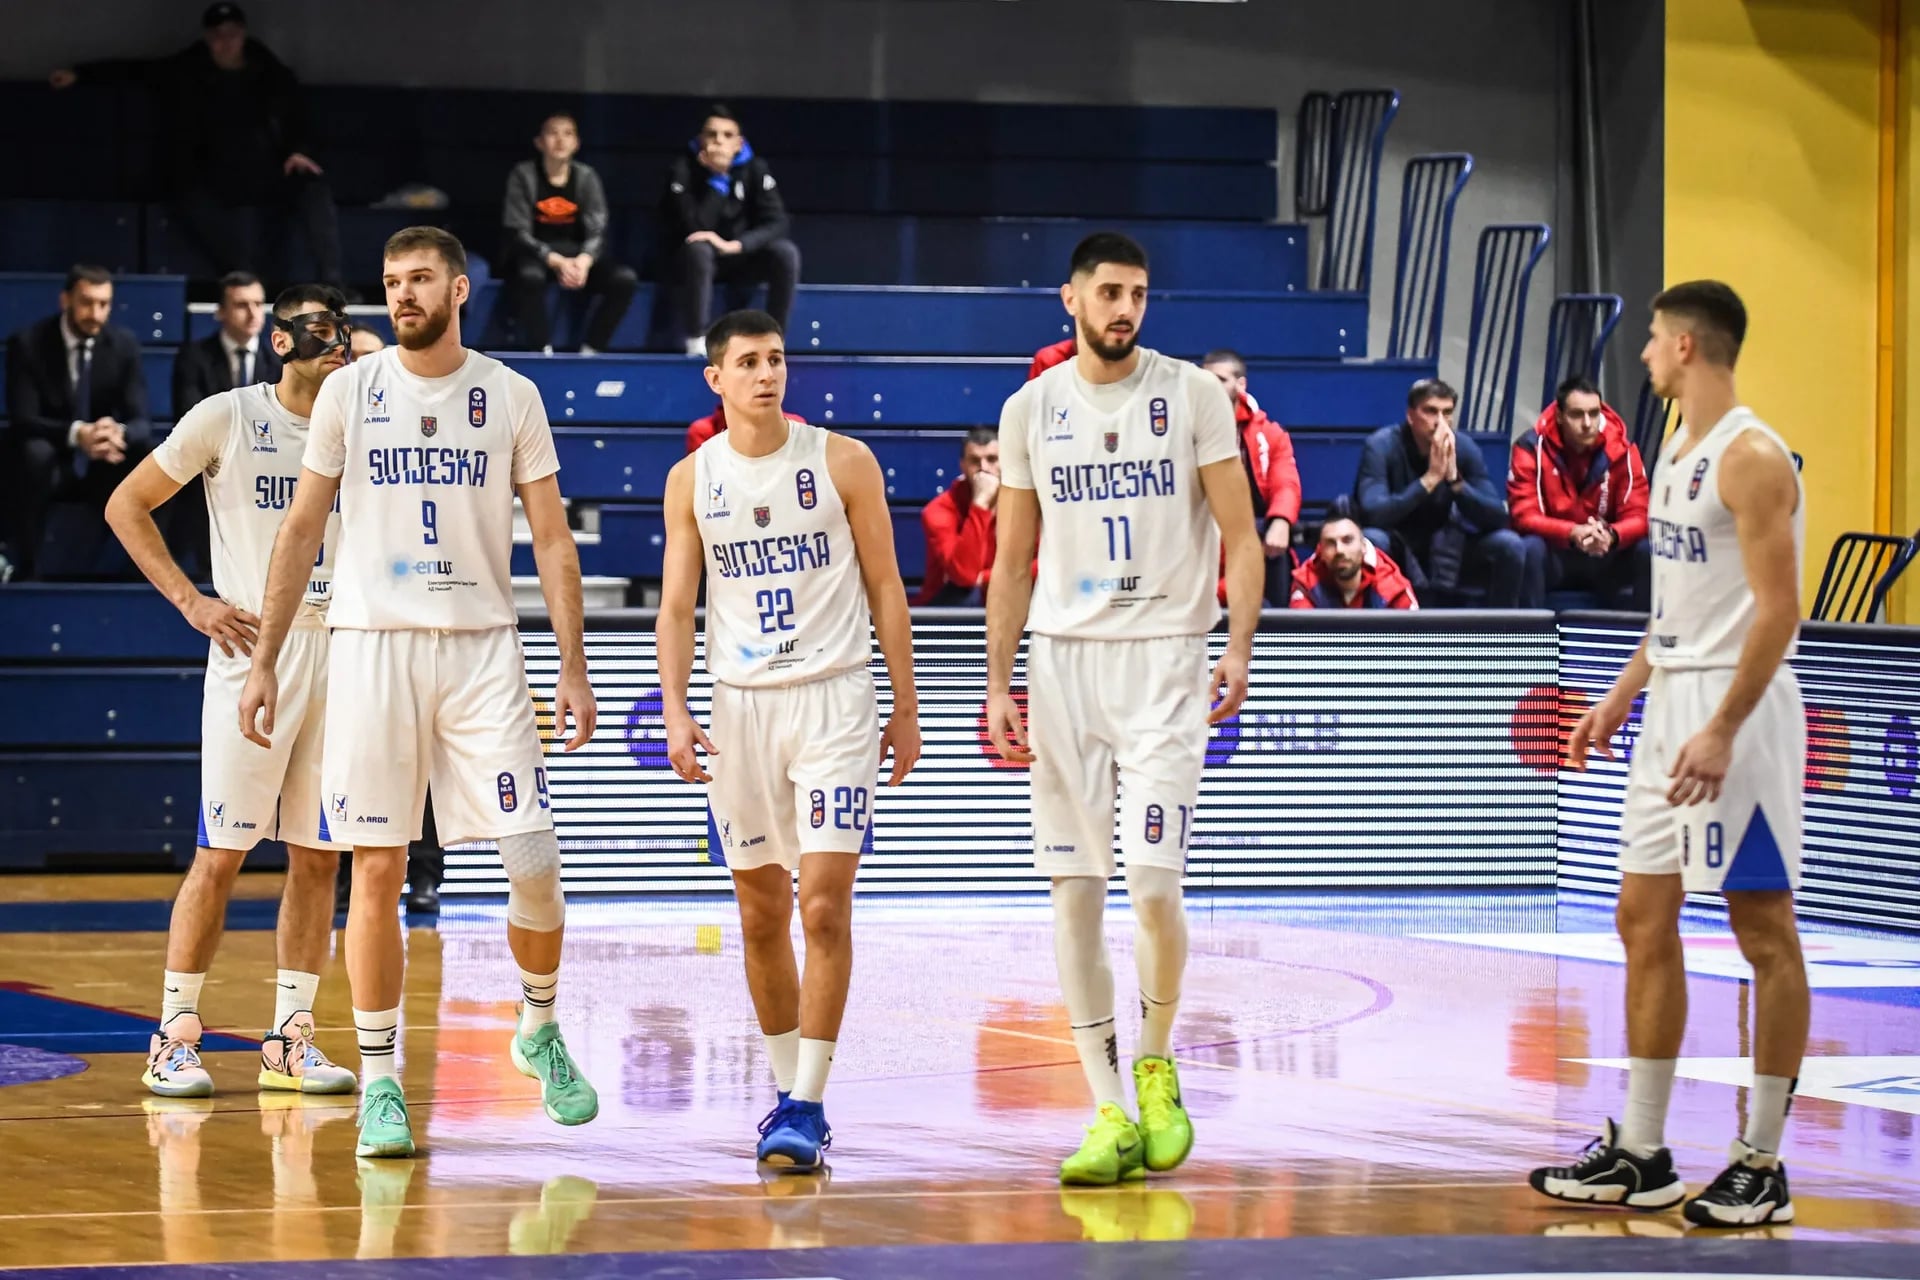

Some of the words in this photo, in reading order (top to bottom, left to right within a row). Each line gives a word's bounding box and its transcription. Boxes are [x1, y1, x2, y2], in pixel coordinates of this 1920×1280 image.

[369, 447, 488, 487] SUTJESKA
[1051, 459, 1175, 503] SUTJESKA
[422, 500, 438, 544] 9
[1102, 515, 1131, 561] 11
[712, 531, 830, 578] SUTJESKA
[756, 587, 796, 634] 22
[1255, 714, 1340, 751] NLB
[534, 767, 550, 809] 9
[834, 786, 868, 831] 22
[366, 816, 389, 824] ARDU
[1706, 821, 1723, 868] 8
